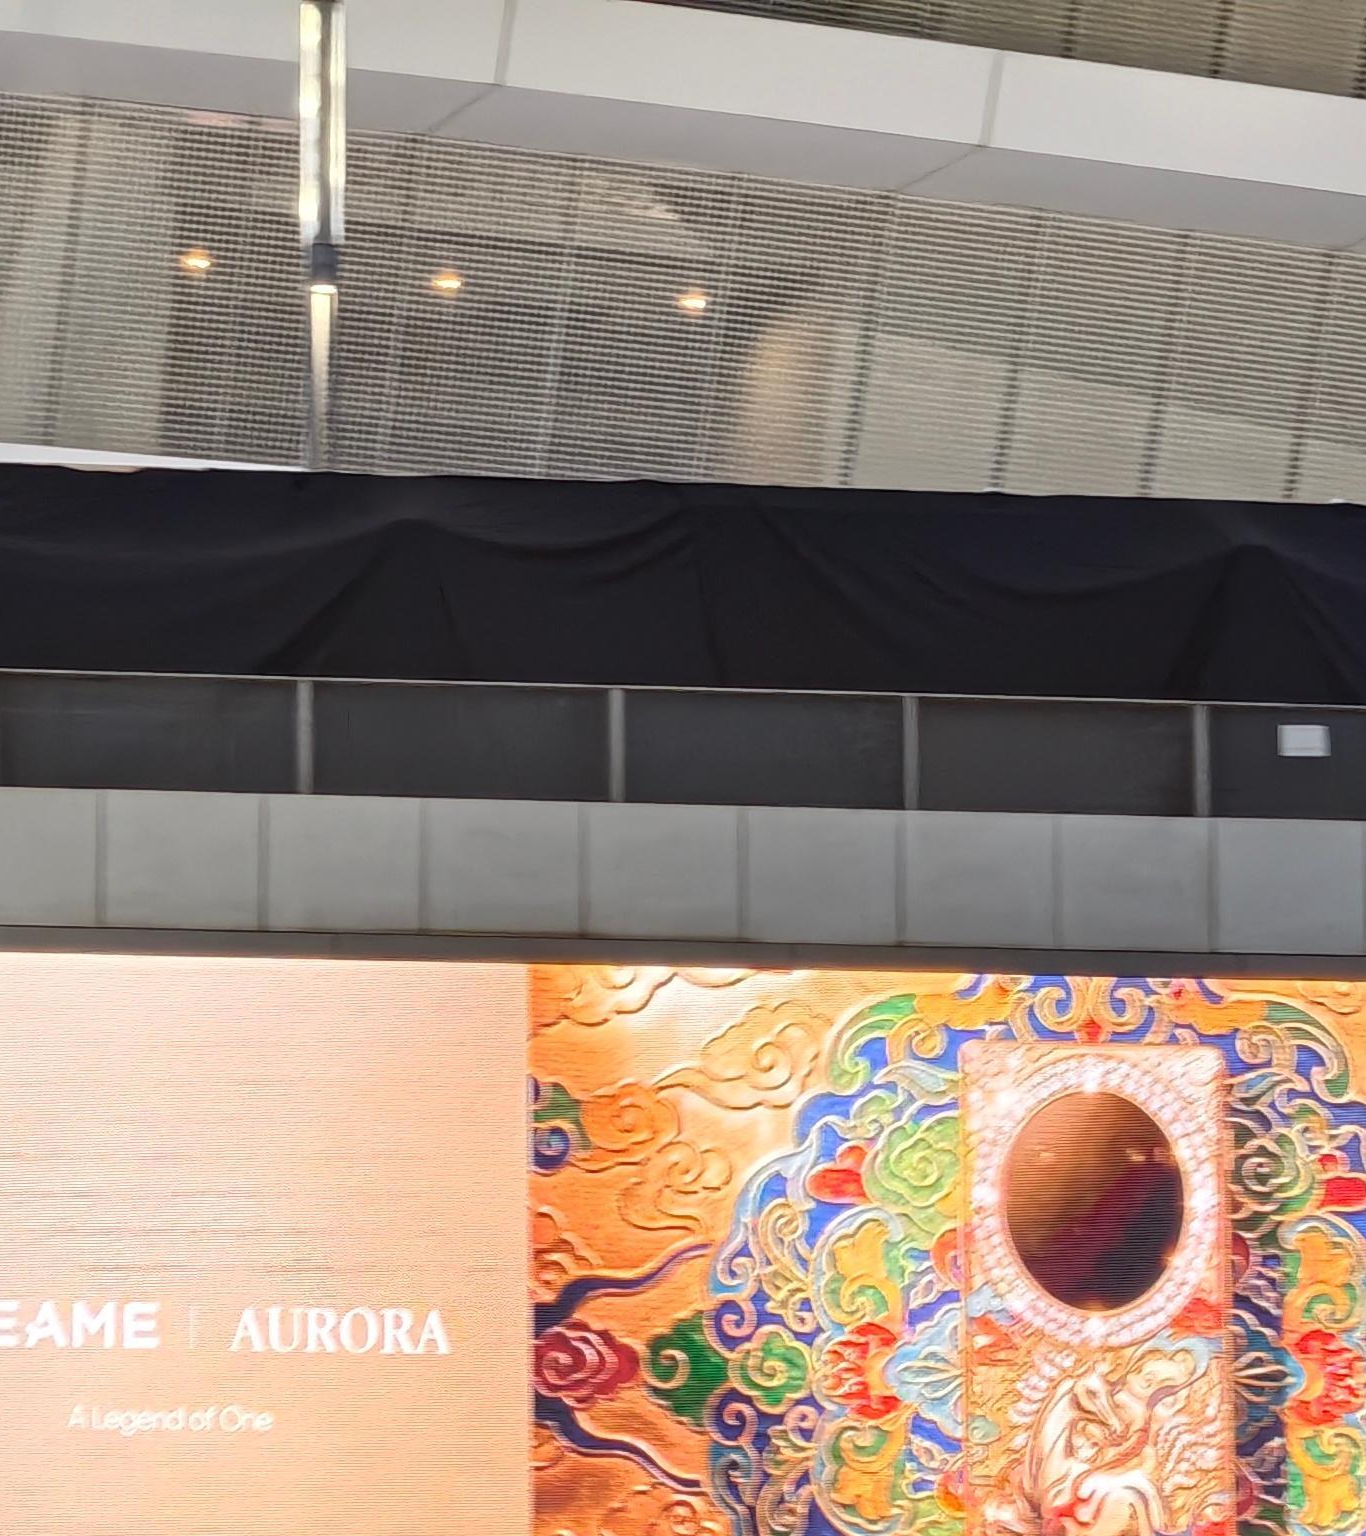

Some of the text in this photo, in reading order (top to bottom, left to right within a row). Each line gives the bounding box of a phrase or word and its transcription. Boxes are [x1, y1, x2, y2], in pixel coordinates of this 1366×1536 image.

[228, 1304, 452, 1355] AURORA
[67, 1404, 274, 1437] A Legend of One
